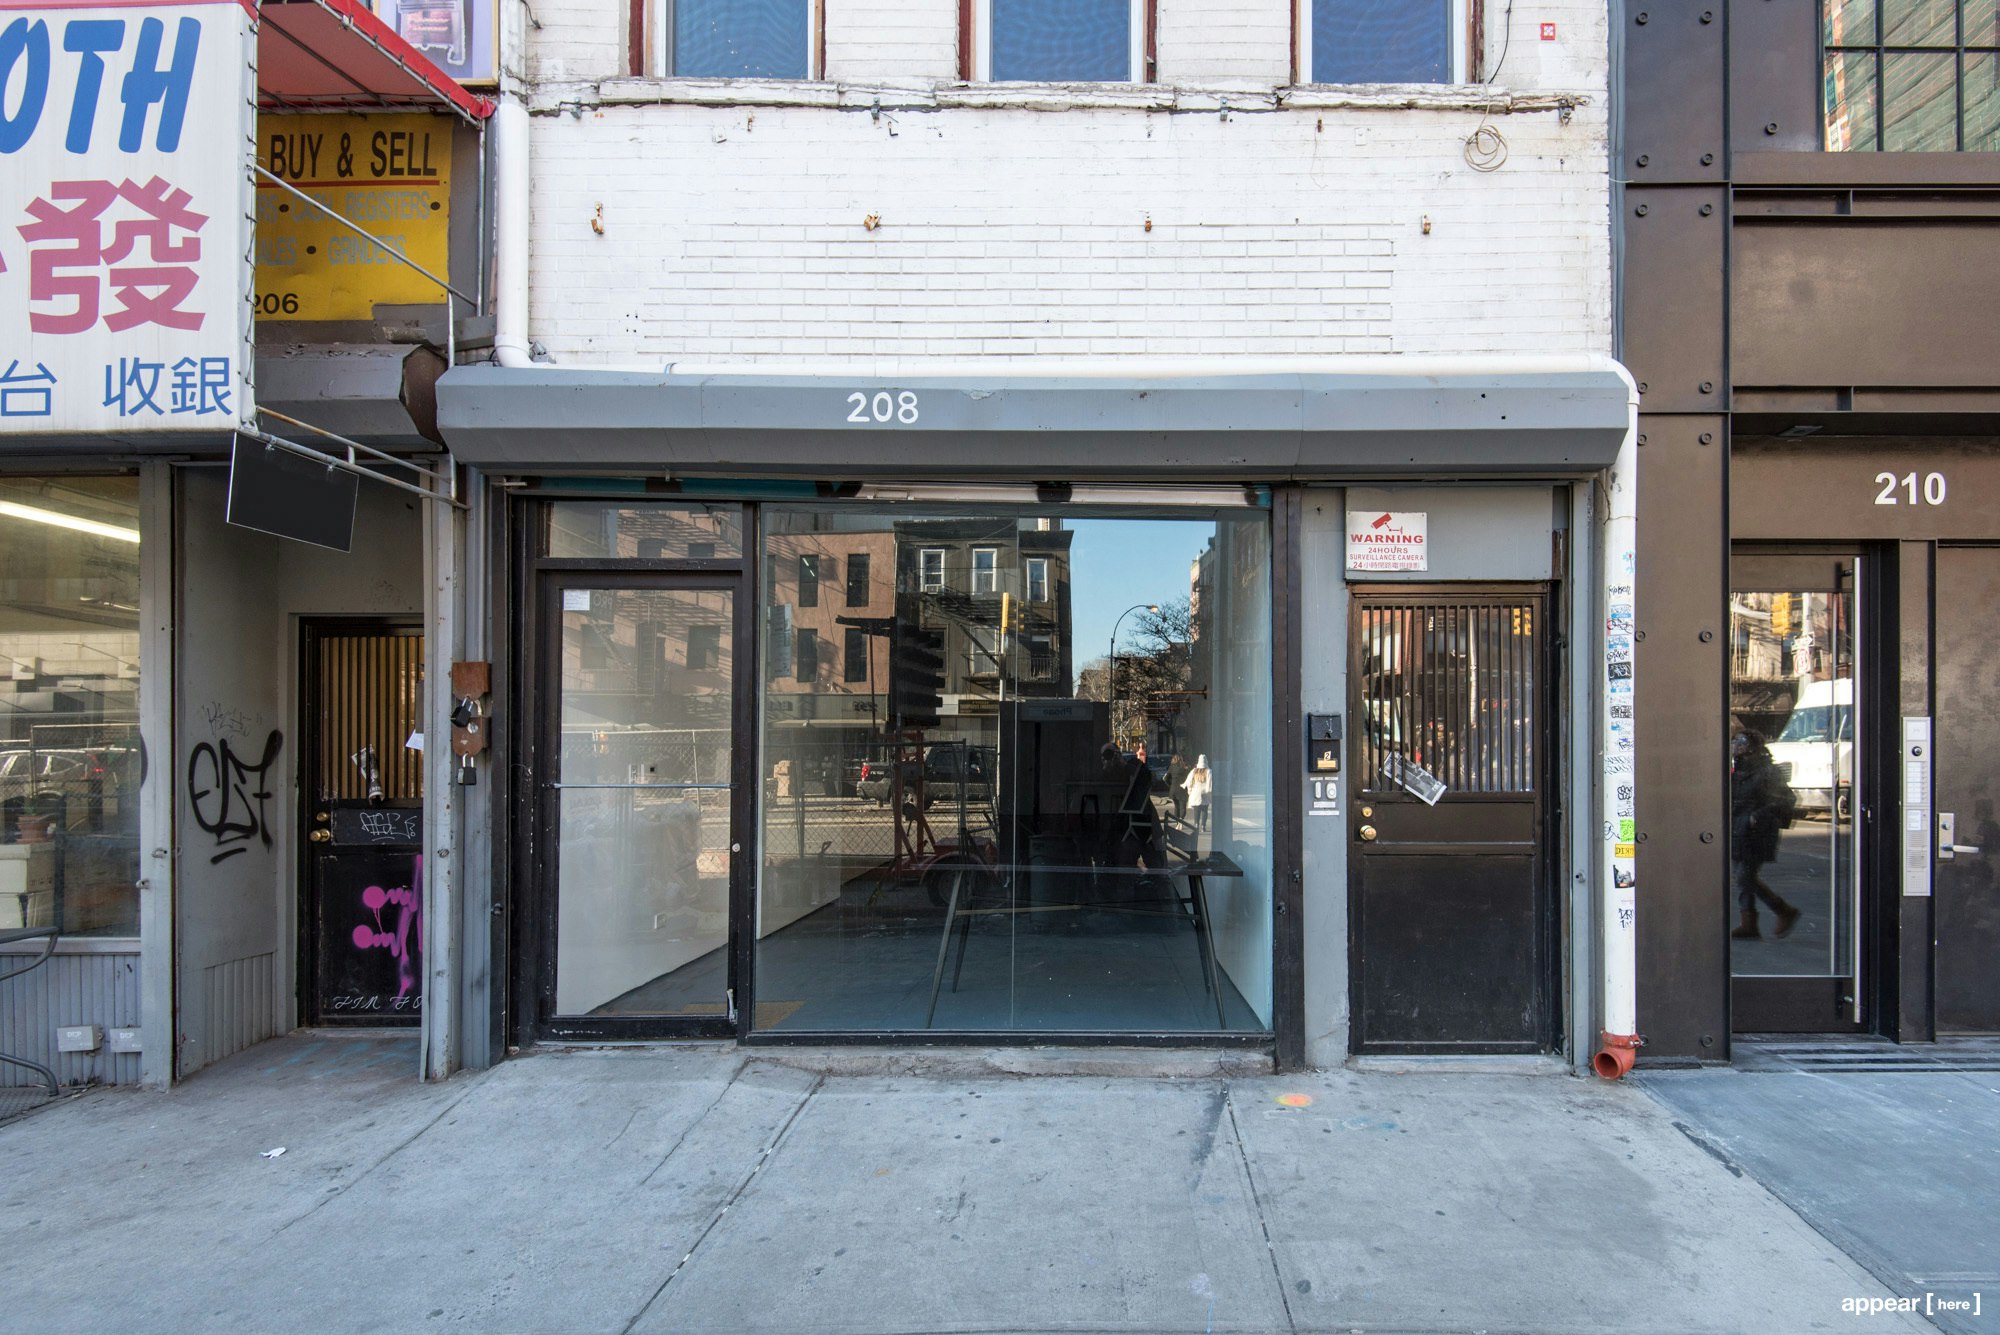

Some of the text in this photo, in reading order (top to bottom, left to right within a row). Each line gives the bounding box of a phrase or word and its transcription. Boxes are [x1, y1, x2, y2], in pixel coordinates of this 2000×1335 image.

[0, 16, 202, 155] OTH
[270, 130, 438, 180] BUY & SELL
[345, 190, 431, 222] REGISTERS
[0, 175, 210, 335] 發
[327, 233, 407, 267] GRINDERS
[102, 357, 233, 417] 收銀
[846, 390, 919, 424] 208
[1873, 471, 1947, 506] 210
[1350, 534, 1424, 544] WARNING
[1349, 553, 1396, 561] SURVEILLANCE
